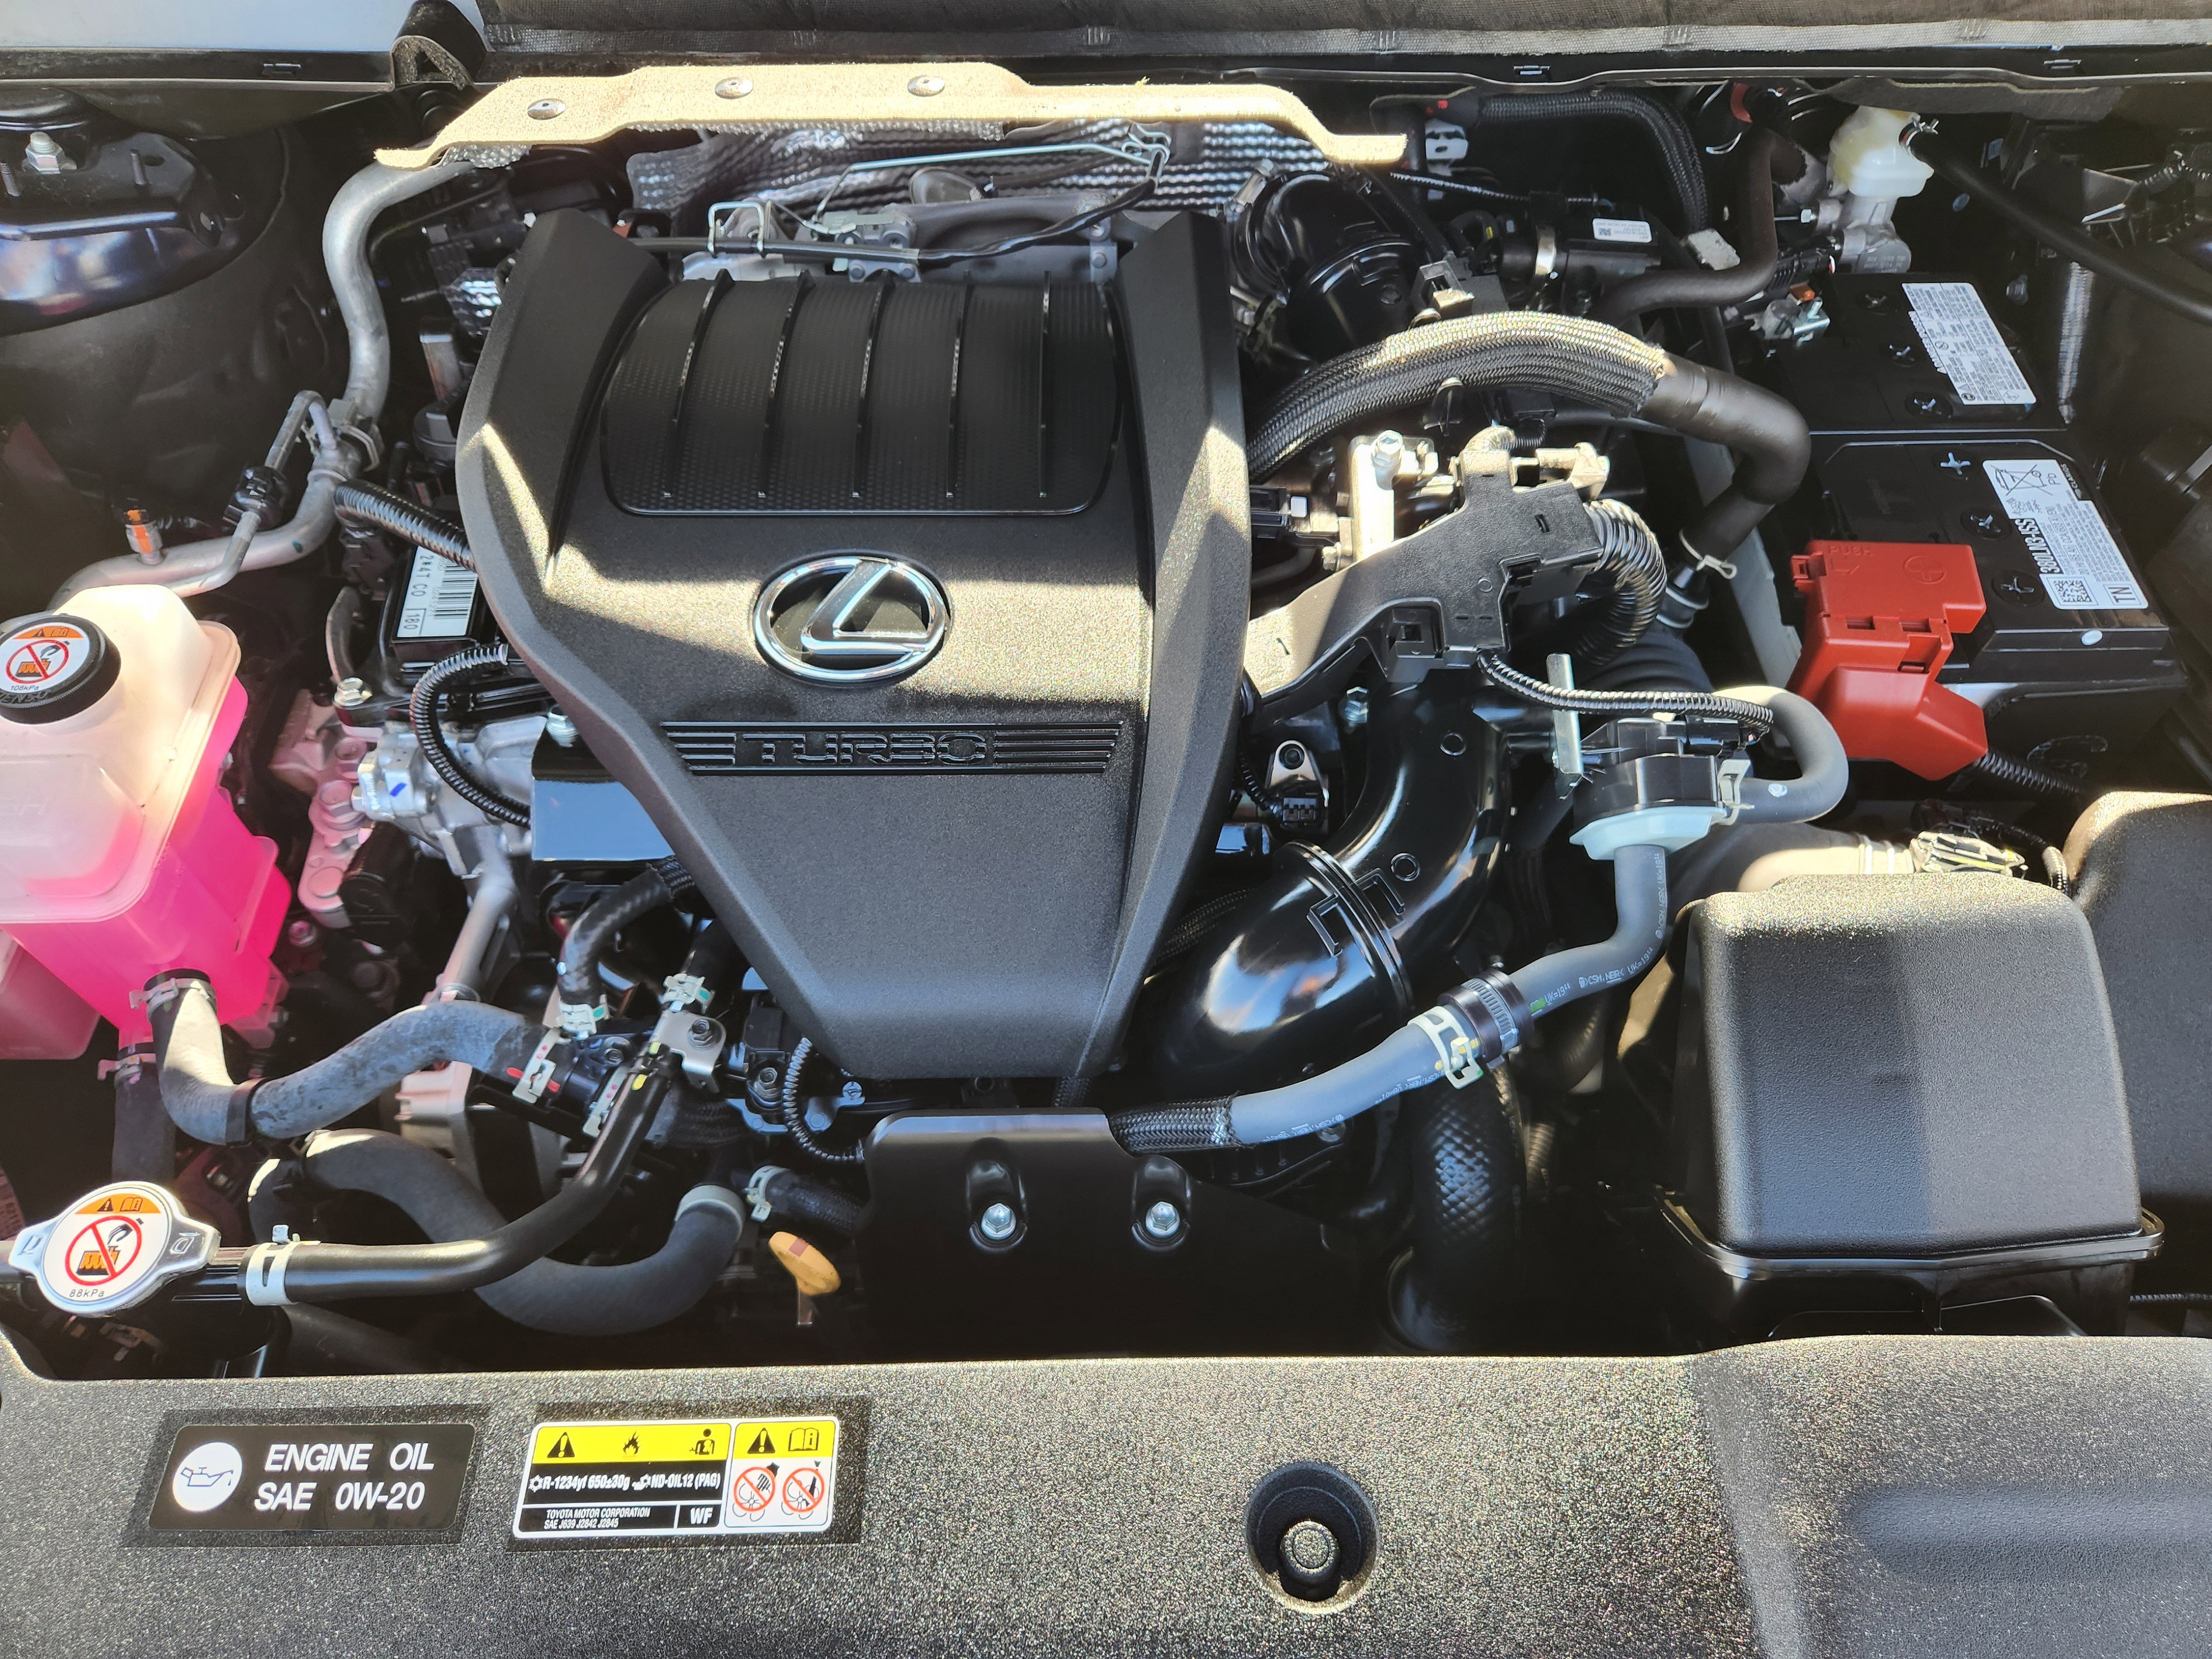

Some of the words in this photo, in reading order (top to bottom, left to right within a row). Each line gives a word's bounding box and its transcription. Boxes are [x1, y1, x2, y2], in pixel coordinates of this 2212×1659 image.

[2047, 473, 2060, 485] Pb
[1828, 545, 1874, 556] PUSH
[2015, 519, 2060, 573] 380LN3-ISS
[2108, 587, 2136, 602] TN
[404, 614, 420, 630] 180
[743, 732, 987, 765] TURBO
[69, 1288, 105, 1297] 88kPa
[264, 1443, 373, 1471] ENGINE
[389, 1442, 434, 1471] OIL
[695, 1473, 721, 1490] (PAG)
[254, 1481, 317, 1511] SAE
[335, 1481, 425, 1511] 0W-20
[546, 1509, 573, 1519] TOYOTA
[573, 1509, 601, 1519] MOTOR
[601, 1507, 651, 1518] CORPORATION
[691, 1507, 713, 1524] WF
[544, 1519, 558, 1530] SAE
[559, 1519, 576, 1529] J639
[576, 1518, 597, 1528] J2842
[597, 1517, 619, 1528] J2845
